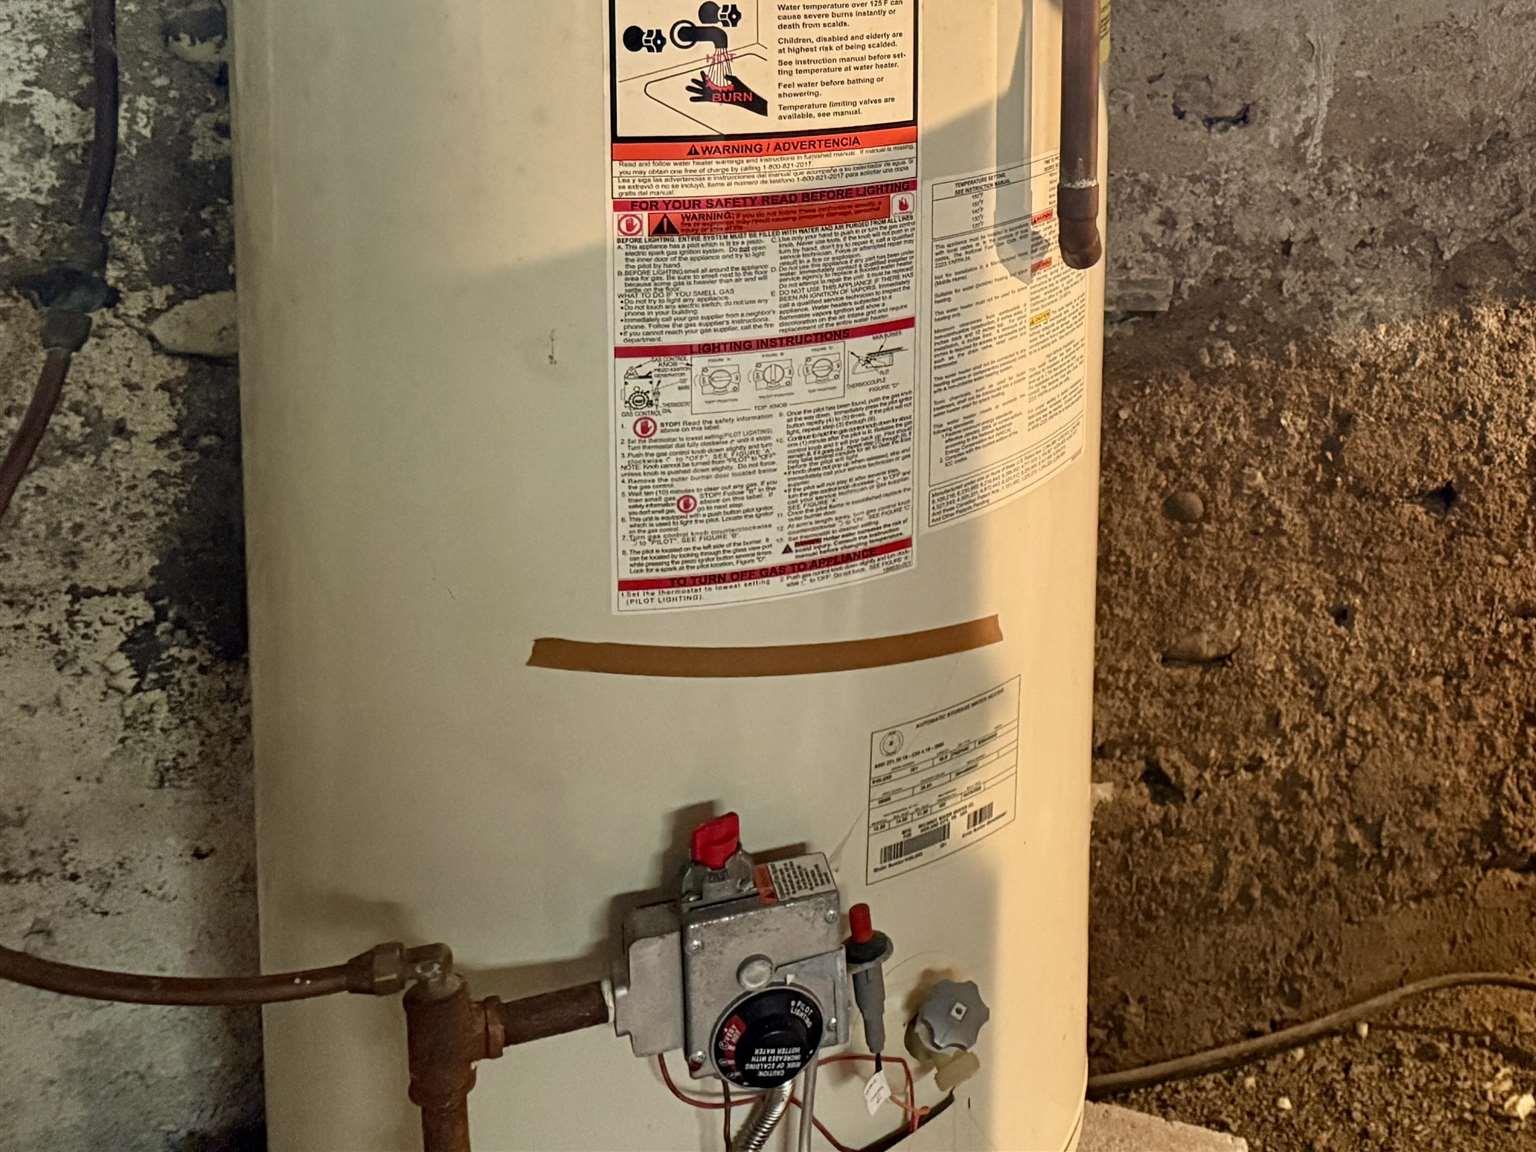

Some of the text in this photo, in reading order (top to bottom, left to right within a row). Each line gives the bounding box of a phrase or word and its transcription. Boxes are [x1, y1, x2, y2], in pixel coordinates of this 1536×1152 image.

[802, 3, 849, 12] temperature
[777, 37, 814, 45] Children,
[787, 46, 817, 54] highest
[845, 43, 866, 51] being
[795, 57, 837, 65] instruction
[839, 55, 867, 63] manual
[868, 53, 891, 61] before
[795, 67, 842, 75] temperature
[820, 79, 845, 87] before
[847, 77, 874, 85] bathing
[712, 92, 753, 102] BURN
[778, 90, 822, 98] showering.
[778, 103, 827, 112] Temperature
[829, 100, 857, 108] limiting
[859, 97, 882, 105] valves
[778, 112, 815, 120] available,
[833, 109, 862, 117] manual.
[701, 143, 763, 155] WARNING
[773, 136, 861, 152] ADVERTENCIA
[631, 181, 910, 211] FOR YOUR SAFETY READ BEFORE LIGHTING
[681, 212, 735, 222] WARNING:
[689, 329, 850, 354] LIGHTING INSTRUCTIONS
[670, 548, 878, 587] TO TURN OFF GAS TO APPLIANCE
